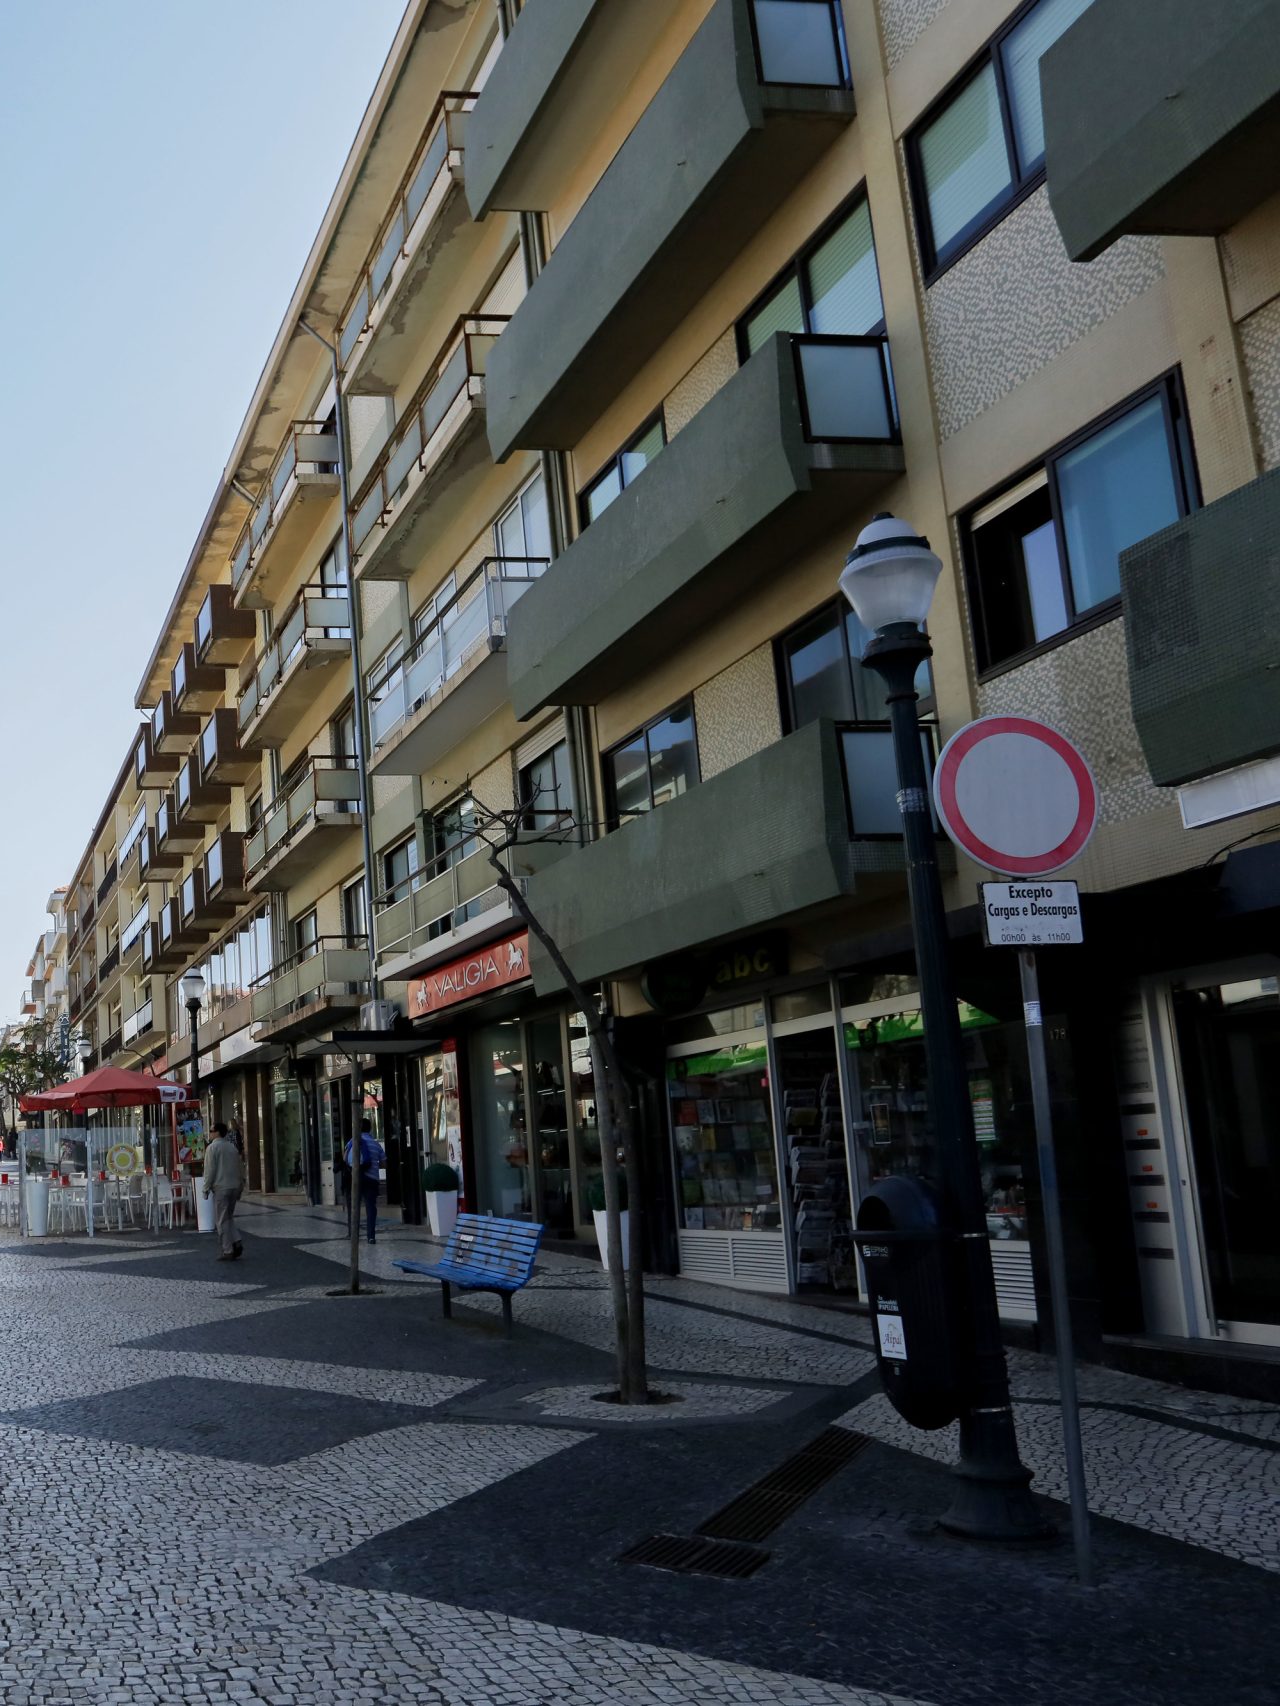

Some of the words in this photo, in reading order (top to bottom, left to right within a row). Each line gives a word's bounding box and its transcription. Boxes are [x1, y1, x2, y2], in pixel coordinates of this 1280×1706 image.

[1008, 885, 1052, 901] Excepto
[988, 903, 1020, 920] Cargas
[1022, 906, 1028, 916] e
[1030, 902, 1078, 919] Descargas
[1047, 932, 1071, 942] 11h00
[715, 948, 770, 984] abc
[434, 954, 501, 998] VALIGIA
